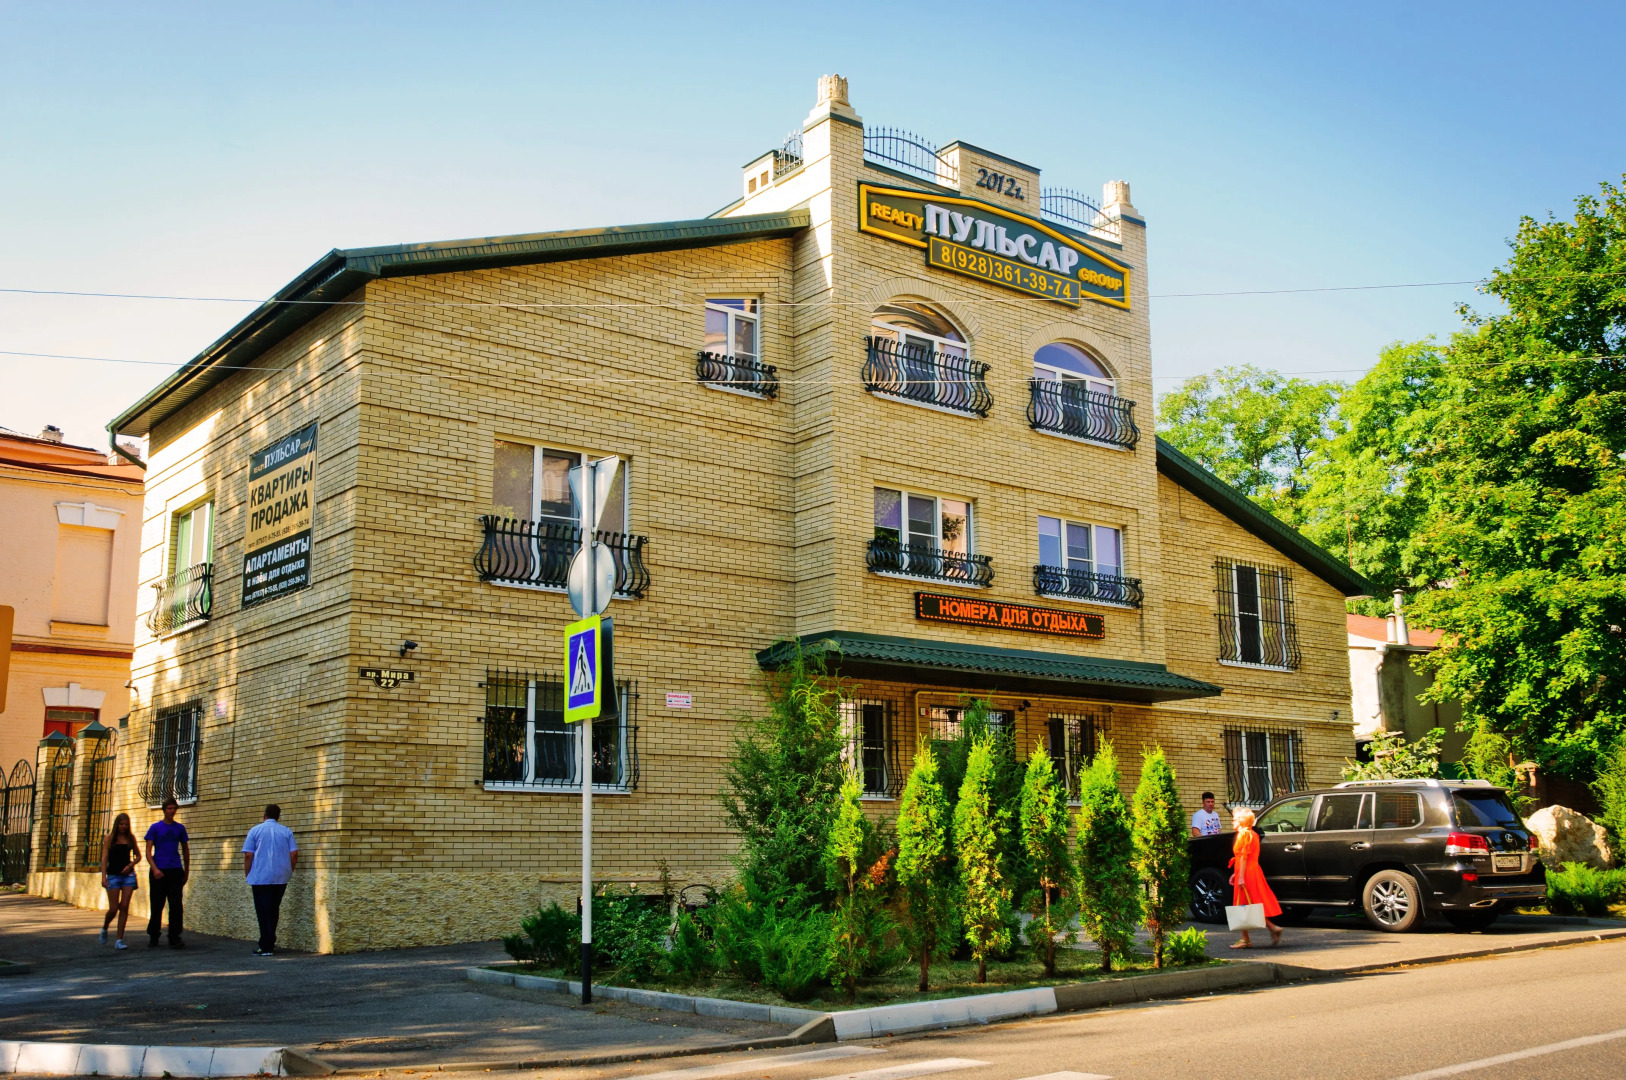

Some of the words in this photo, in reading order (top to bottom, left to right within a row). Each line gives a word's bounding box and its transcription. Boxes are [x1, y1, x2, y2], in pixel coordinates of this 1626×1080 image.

[870, 202, 923, 230] REALTY
[924, 203, 1079, 275] ПУЛЬСАР
[1078, 267, 1123, 291] GROUP
[940, 245, 1072, 300] 8(928)361-39-74
[264, 438, 301, 469] ПУЛЬСАР
[250, 460, 313, 508] КВАРТИРЫ
[251, 489, 308, 532] ПРОДАЖА
[245, 535, 310, 574] АПАРТАМЕНТЫ
[268, 567, 281, 581] для
[281, 558, 305, 575] отдыха
[939, 599, 998, 621] НОМЕРА
[1001, 607, 1029, 627] ДЛЯ
[1032, 612, 1088, 632] ОТДЫХА
[380, 679, 395, 688] 22
[381, 670, 409, 680] Мира
